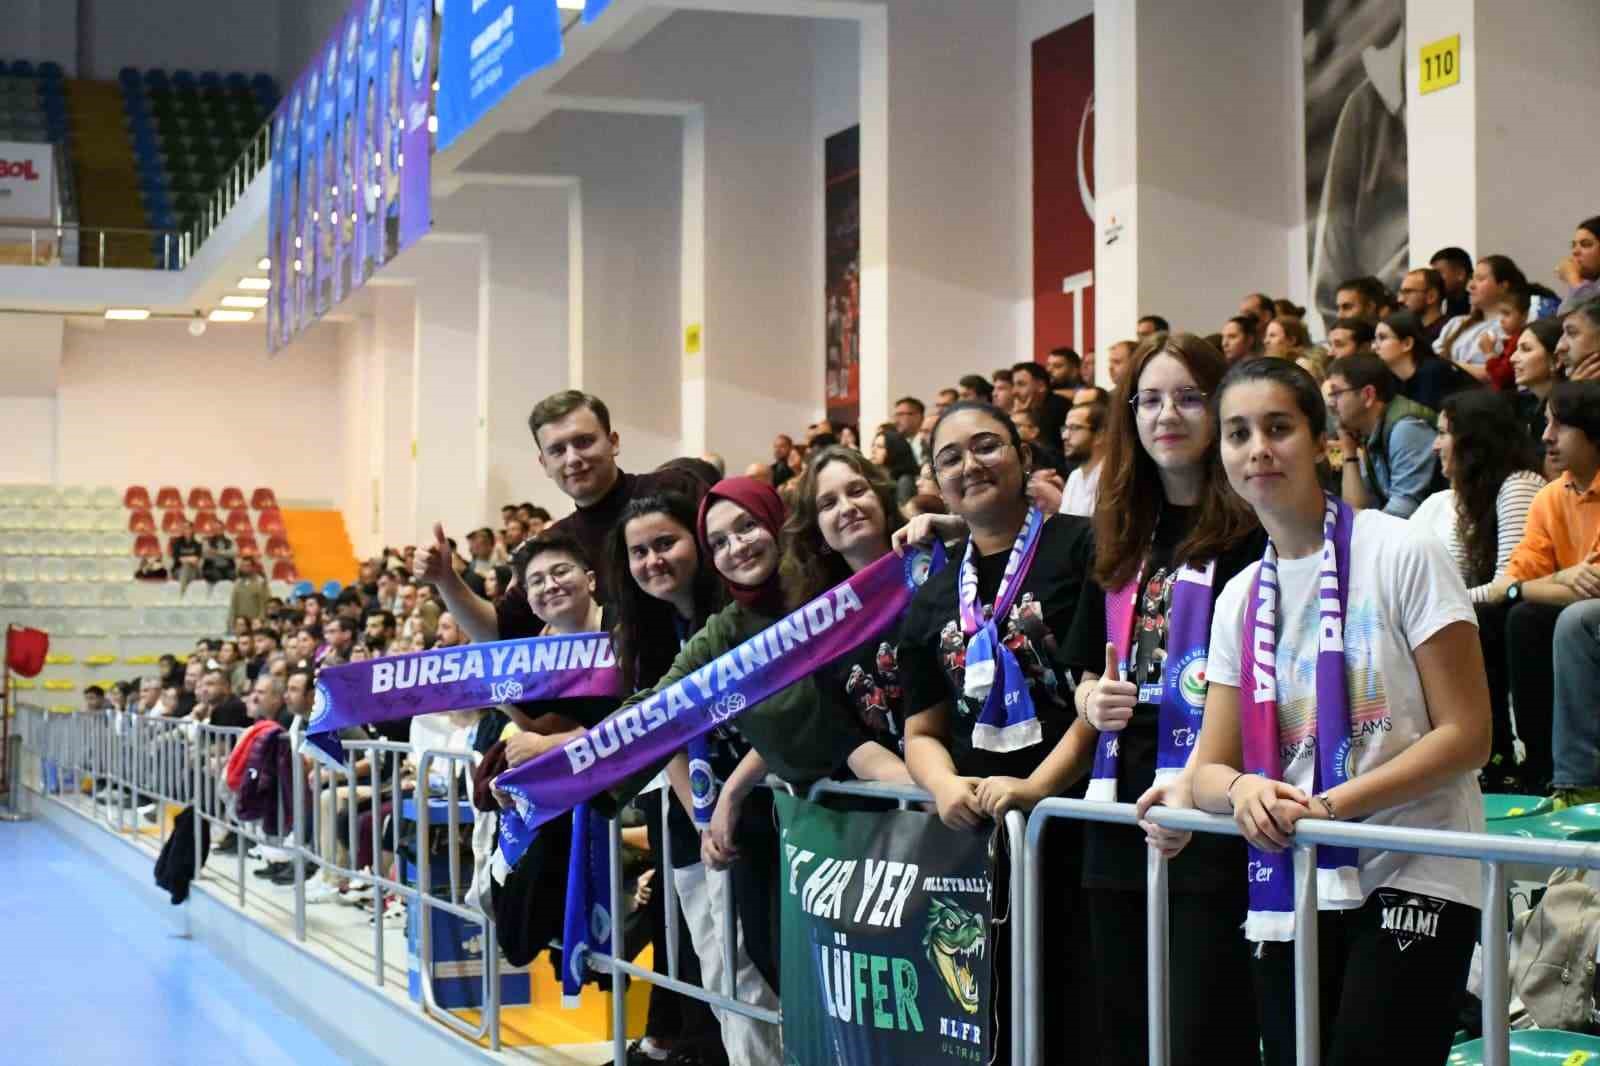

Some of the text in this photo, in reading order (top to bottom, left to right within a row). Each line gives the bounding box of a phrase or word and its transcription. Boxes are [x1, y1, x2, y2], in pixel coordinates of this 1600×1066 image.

[1423, 49, 1454, 81] 110
[371, 649, 485, 694] BURSA
[564, 583, 864, 775] BURSA YANINDA
[853, 858, 919, 928] YER
[1381, 907, 1439, 937] MIAMI
